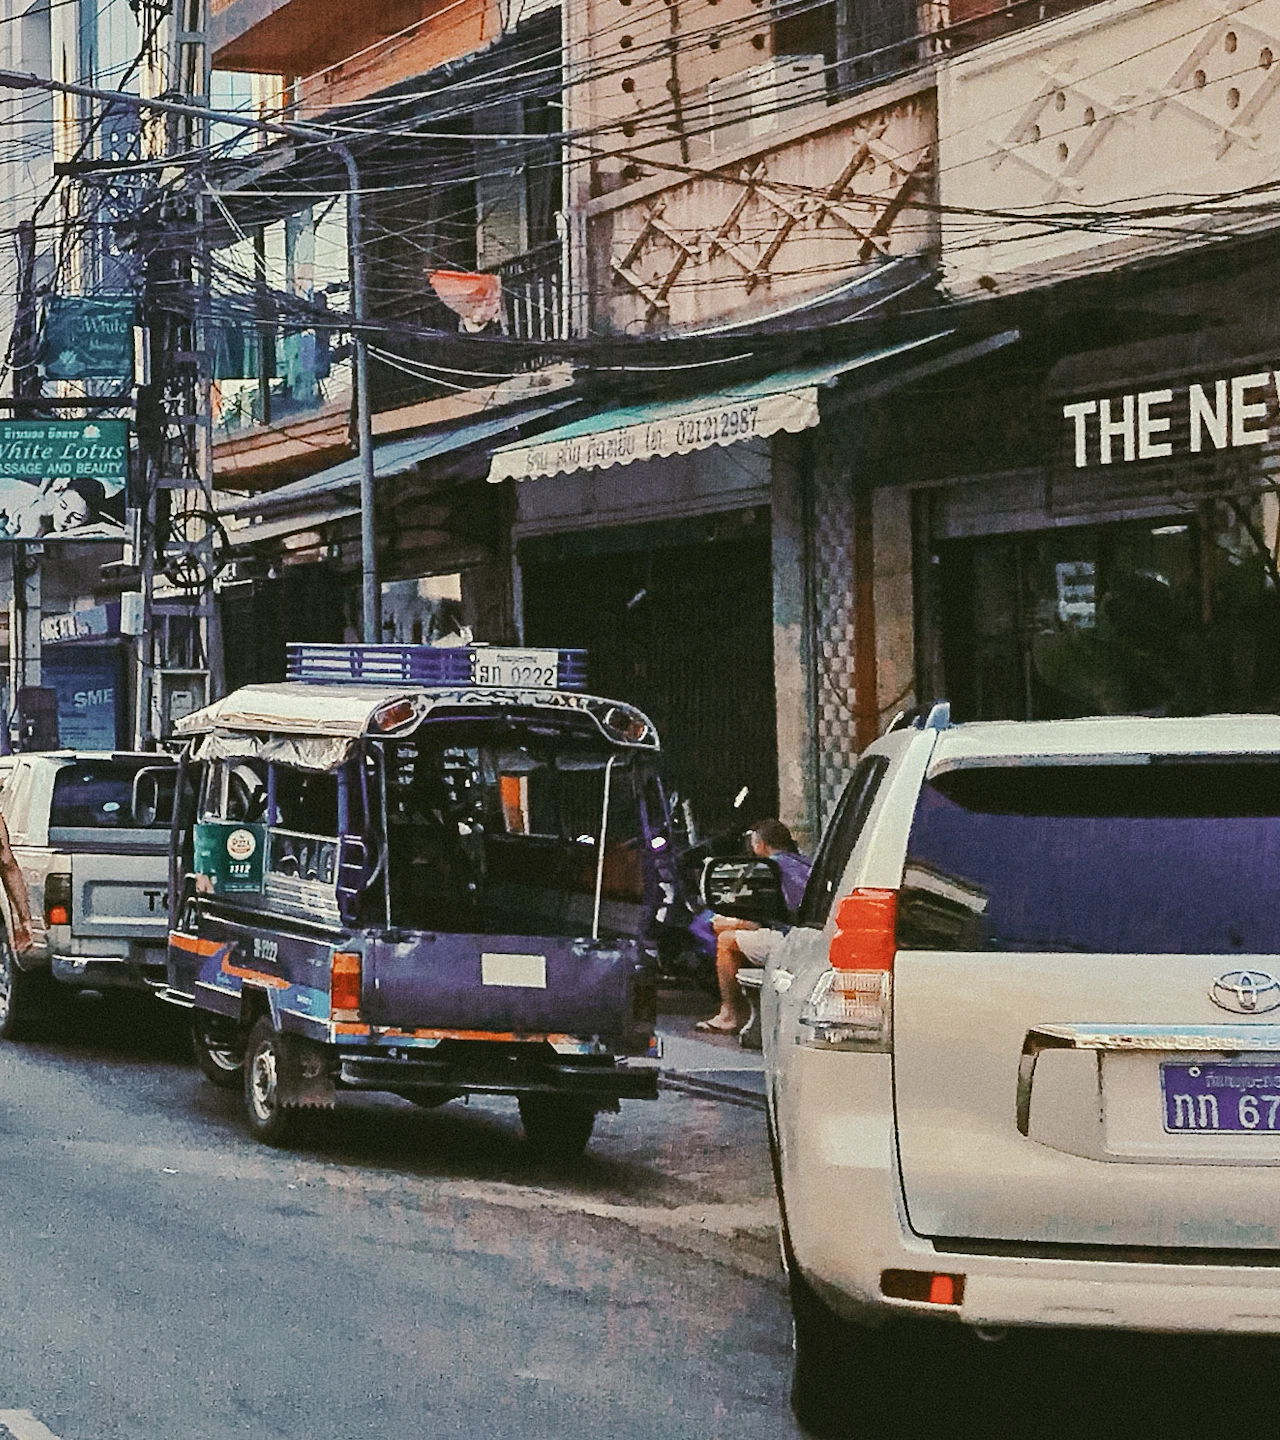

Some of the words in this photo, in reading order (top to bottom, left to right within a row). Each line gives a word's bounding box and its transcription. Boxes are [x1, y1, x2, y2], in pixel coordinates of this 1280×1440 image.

[1063, 388, 1173, 469] THE
[1189, 370, 1280, 453] NE
[59, 442, 125, 460] Lotus
[47, 462, 72, 474] AND
[76, 462, 123, 474] BEAUTY
[511, 666, 554, 686] 0222
[73, 688, 114, 709] SME
[1238, 1094, 1280, 1130] 67
